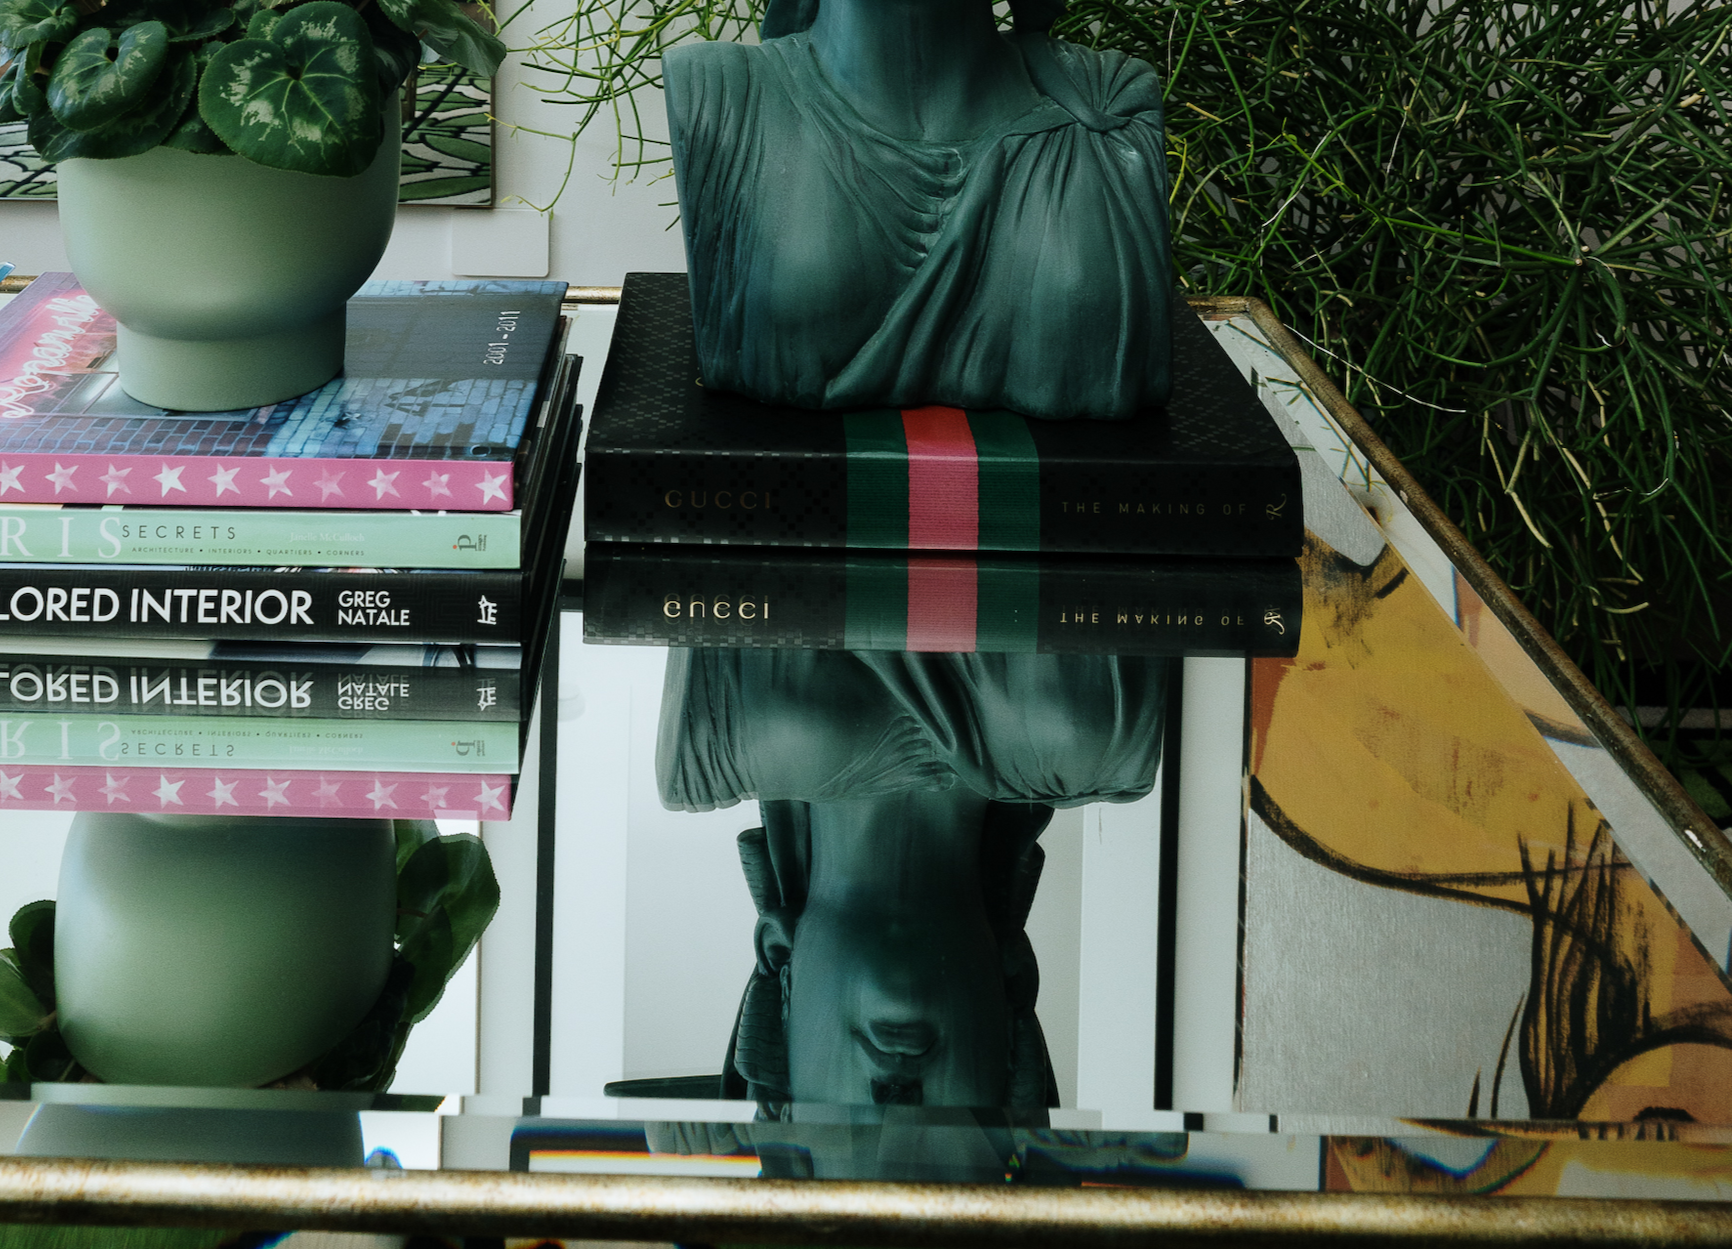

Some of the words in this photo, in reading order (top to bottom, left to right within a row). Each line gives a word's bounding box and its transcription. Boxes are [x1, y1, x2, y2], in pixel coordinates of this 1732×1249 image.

[483, 342, 509, 365] 2001
[496, 311, 521, 332] 2011
[664, 489, 770, 509] GUCCI
[1061, 502, 1101, 513] THE
[1119, 503, 1205, 515] MAKING
[1222, 504, 1246, 515] OF
[122, 525, 236, 540] SECRETS
[208, 547, 252, 555] INTERIORS
[266, 548, 313, 556] QUARTIERS
[130, 588, 314, 624] INTERIOR
[338, 590, 391, 608] GREG
[338, 609, 410, 626] NATALE
